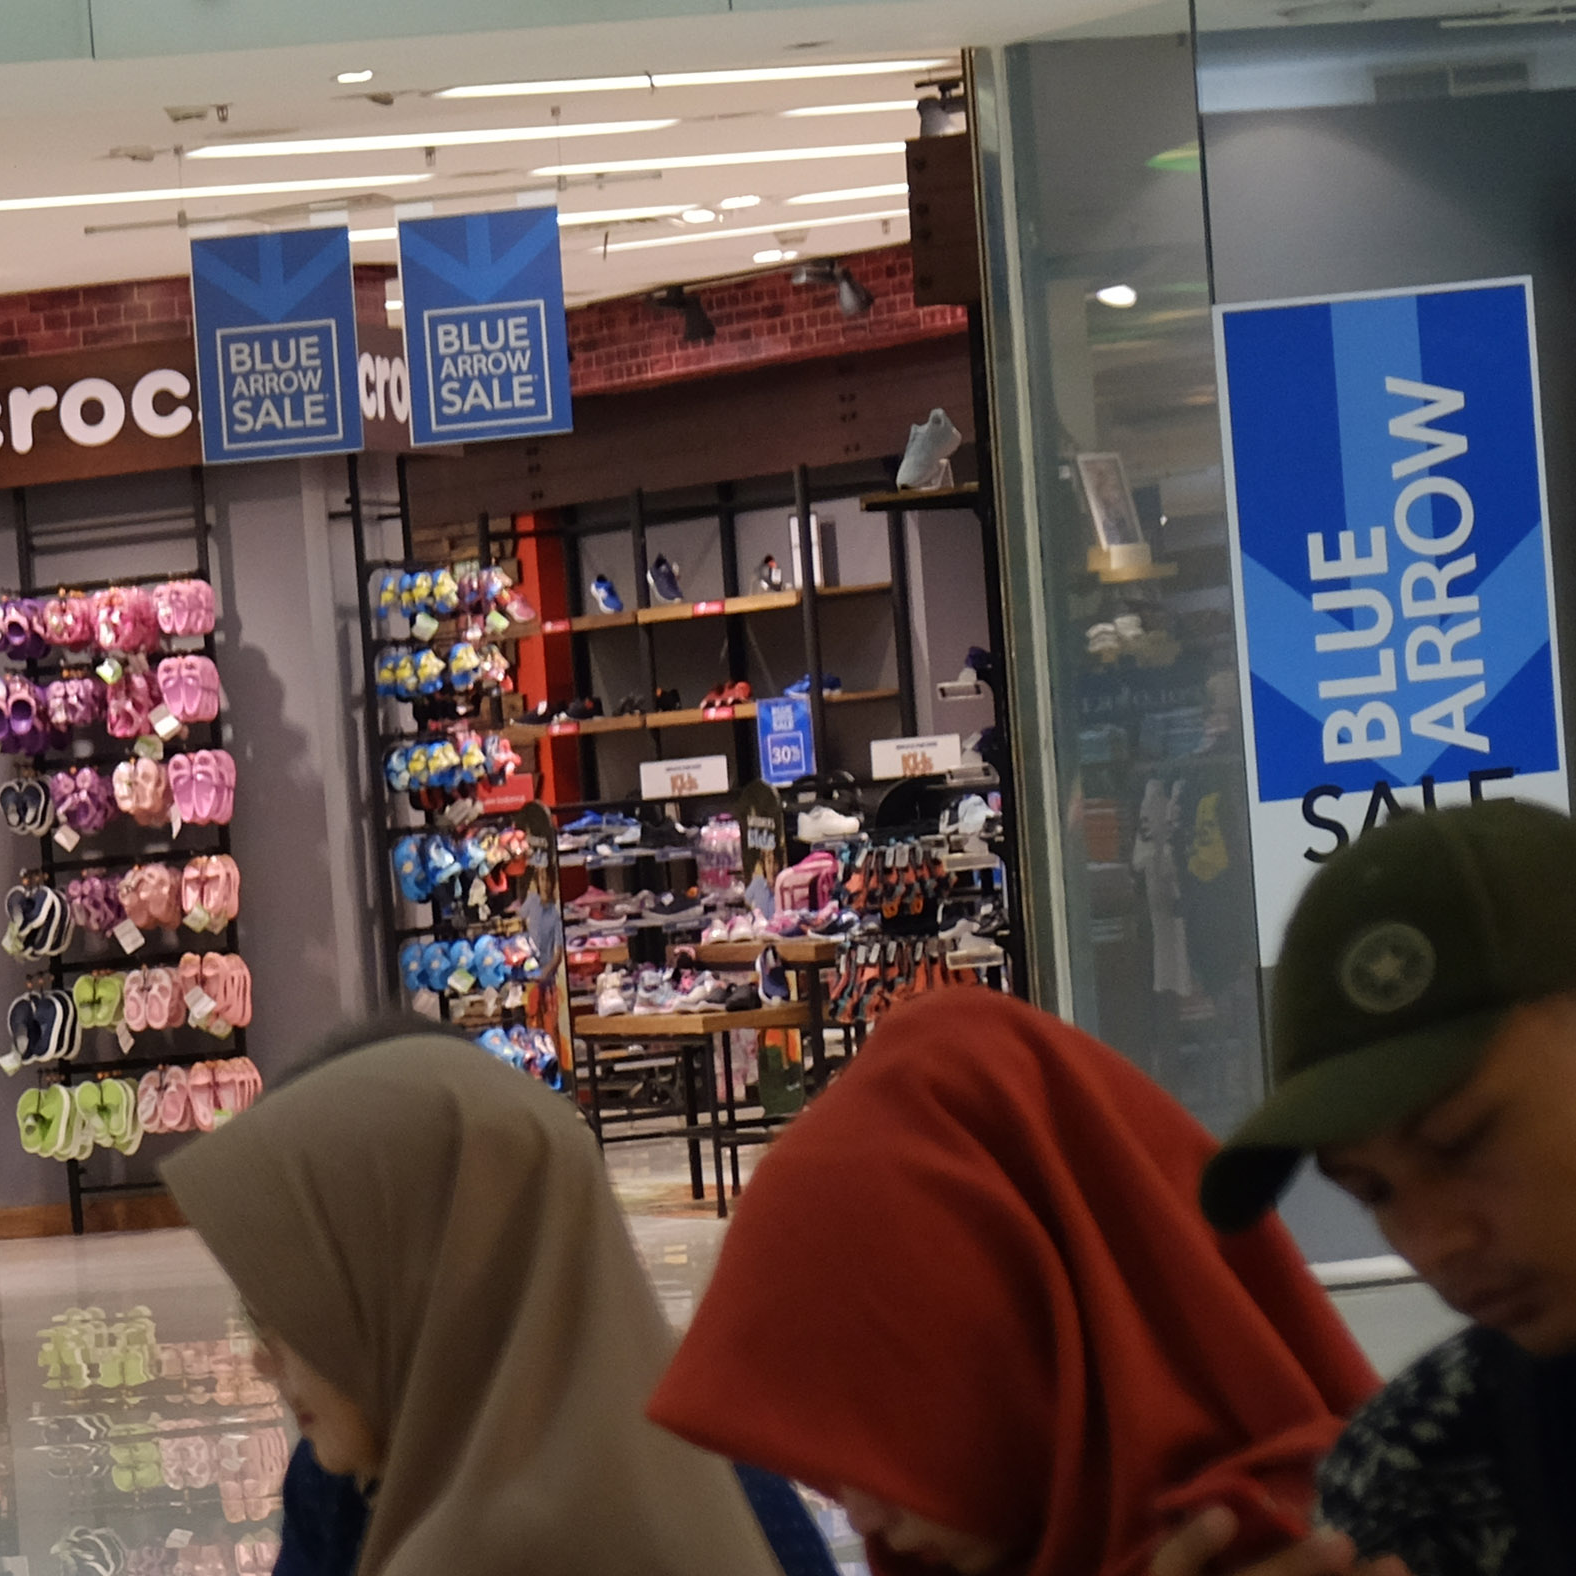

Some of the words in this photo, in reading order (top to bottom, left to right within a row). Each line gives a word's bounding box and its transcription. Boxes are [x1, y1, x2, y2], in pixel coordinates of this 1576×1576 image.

[229, 335, 322, 374] BLUE
[436, 316, 530, 354] BLUE
[232, 368, 324, 400] ARROW
[440, 349, 532, 380] ARROW
[358, 352, 410, 423] cro
[441, 374, 537, 415] SALE
[232, 393, 329, 434] SALE
[1385, 375, 1490, 754] ARROW
[1308, 525, 1402, 764] BLUE
